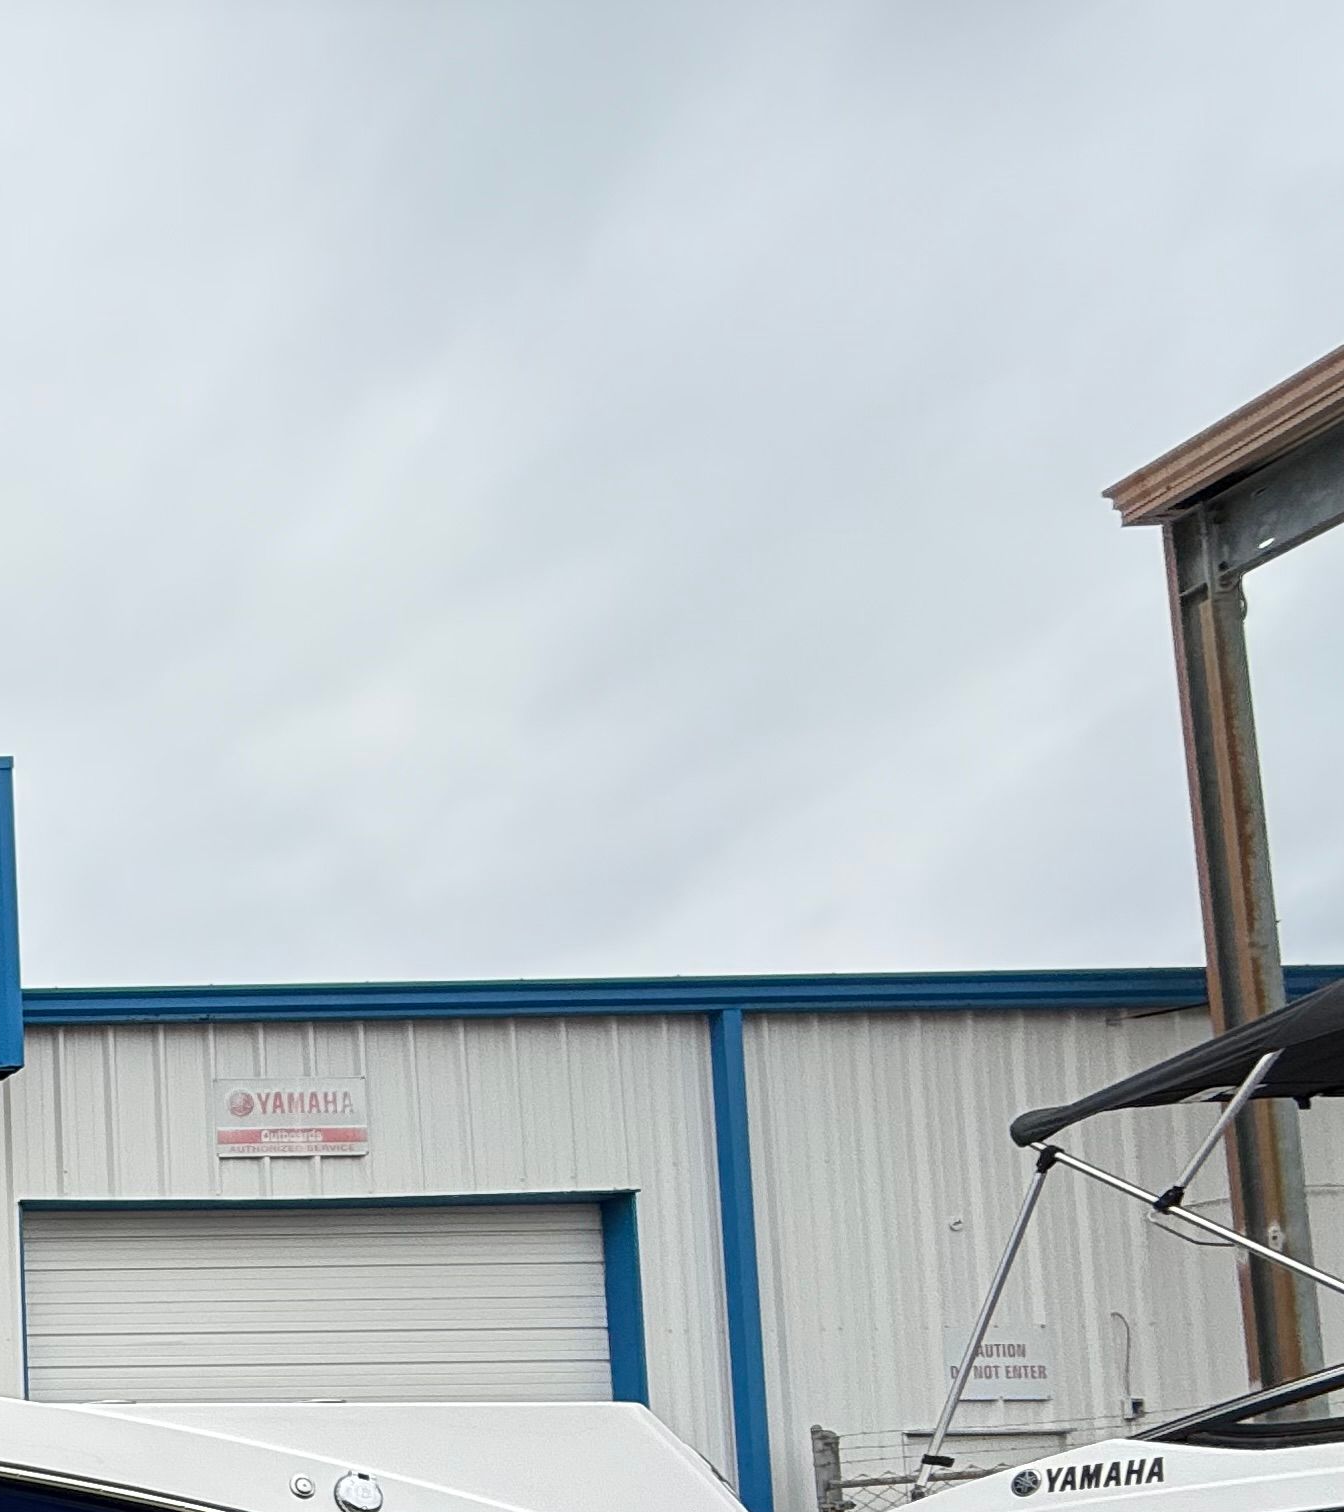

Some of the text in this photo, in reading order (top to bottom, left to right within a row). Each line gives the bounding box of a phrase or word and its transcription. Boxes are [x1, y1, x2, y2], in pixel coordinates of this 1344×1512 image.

[256, 1091, 354, 1114] YAMAHA
[976, 1343, 1026, 1358] AUTION
[973, 1365, 1000, 1379] NOT
[1005, 1365, 1047, 1379] ENTER
[1046, 1457, 1165, 1493] YAMAHA
